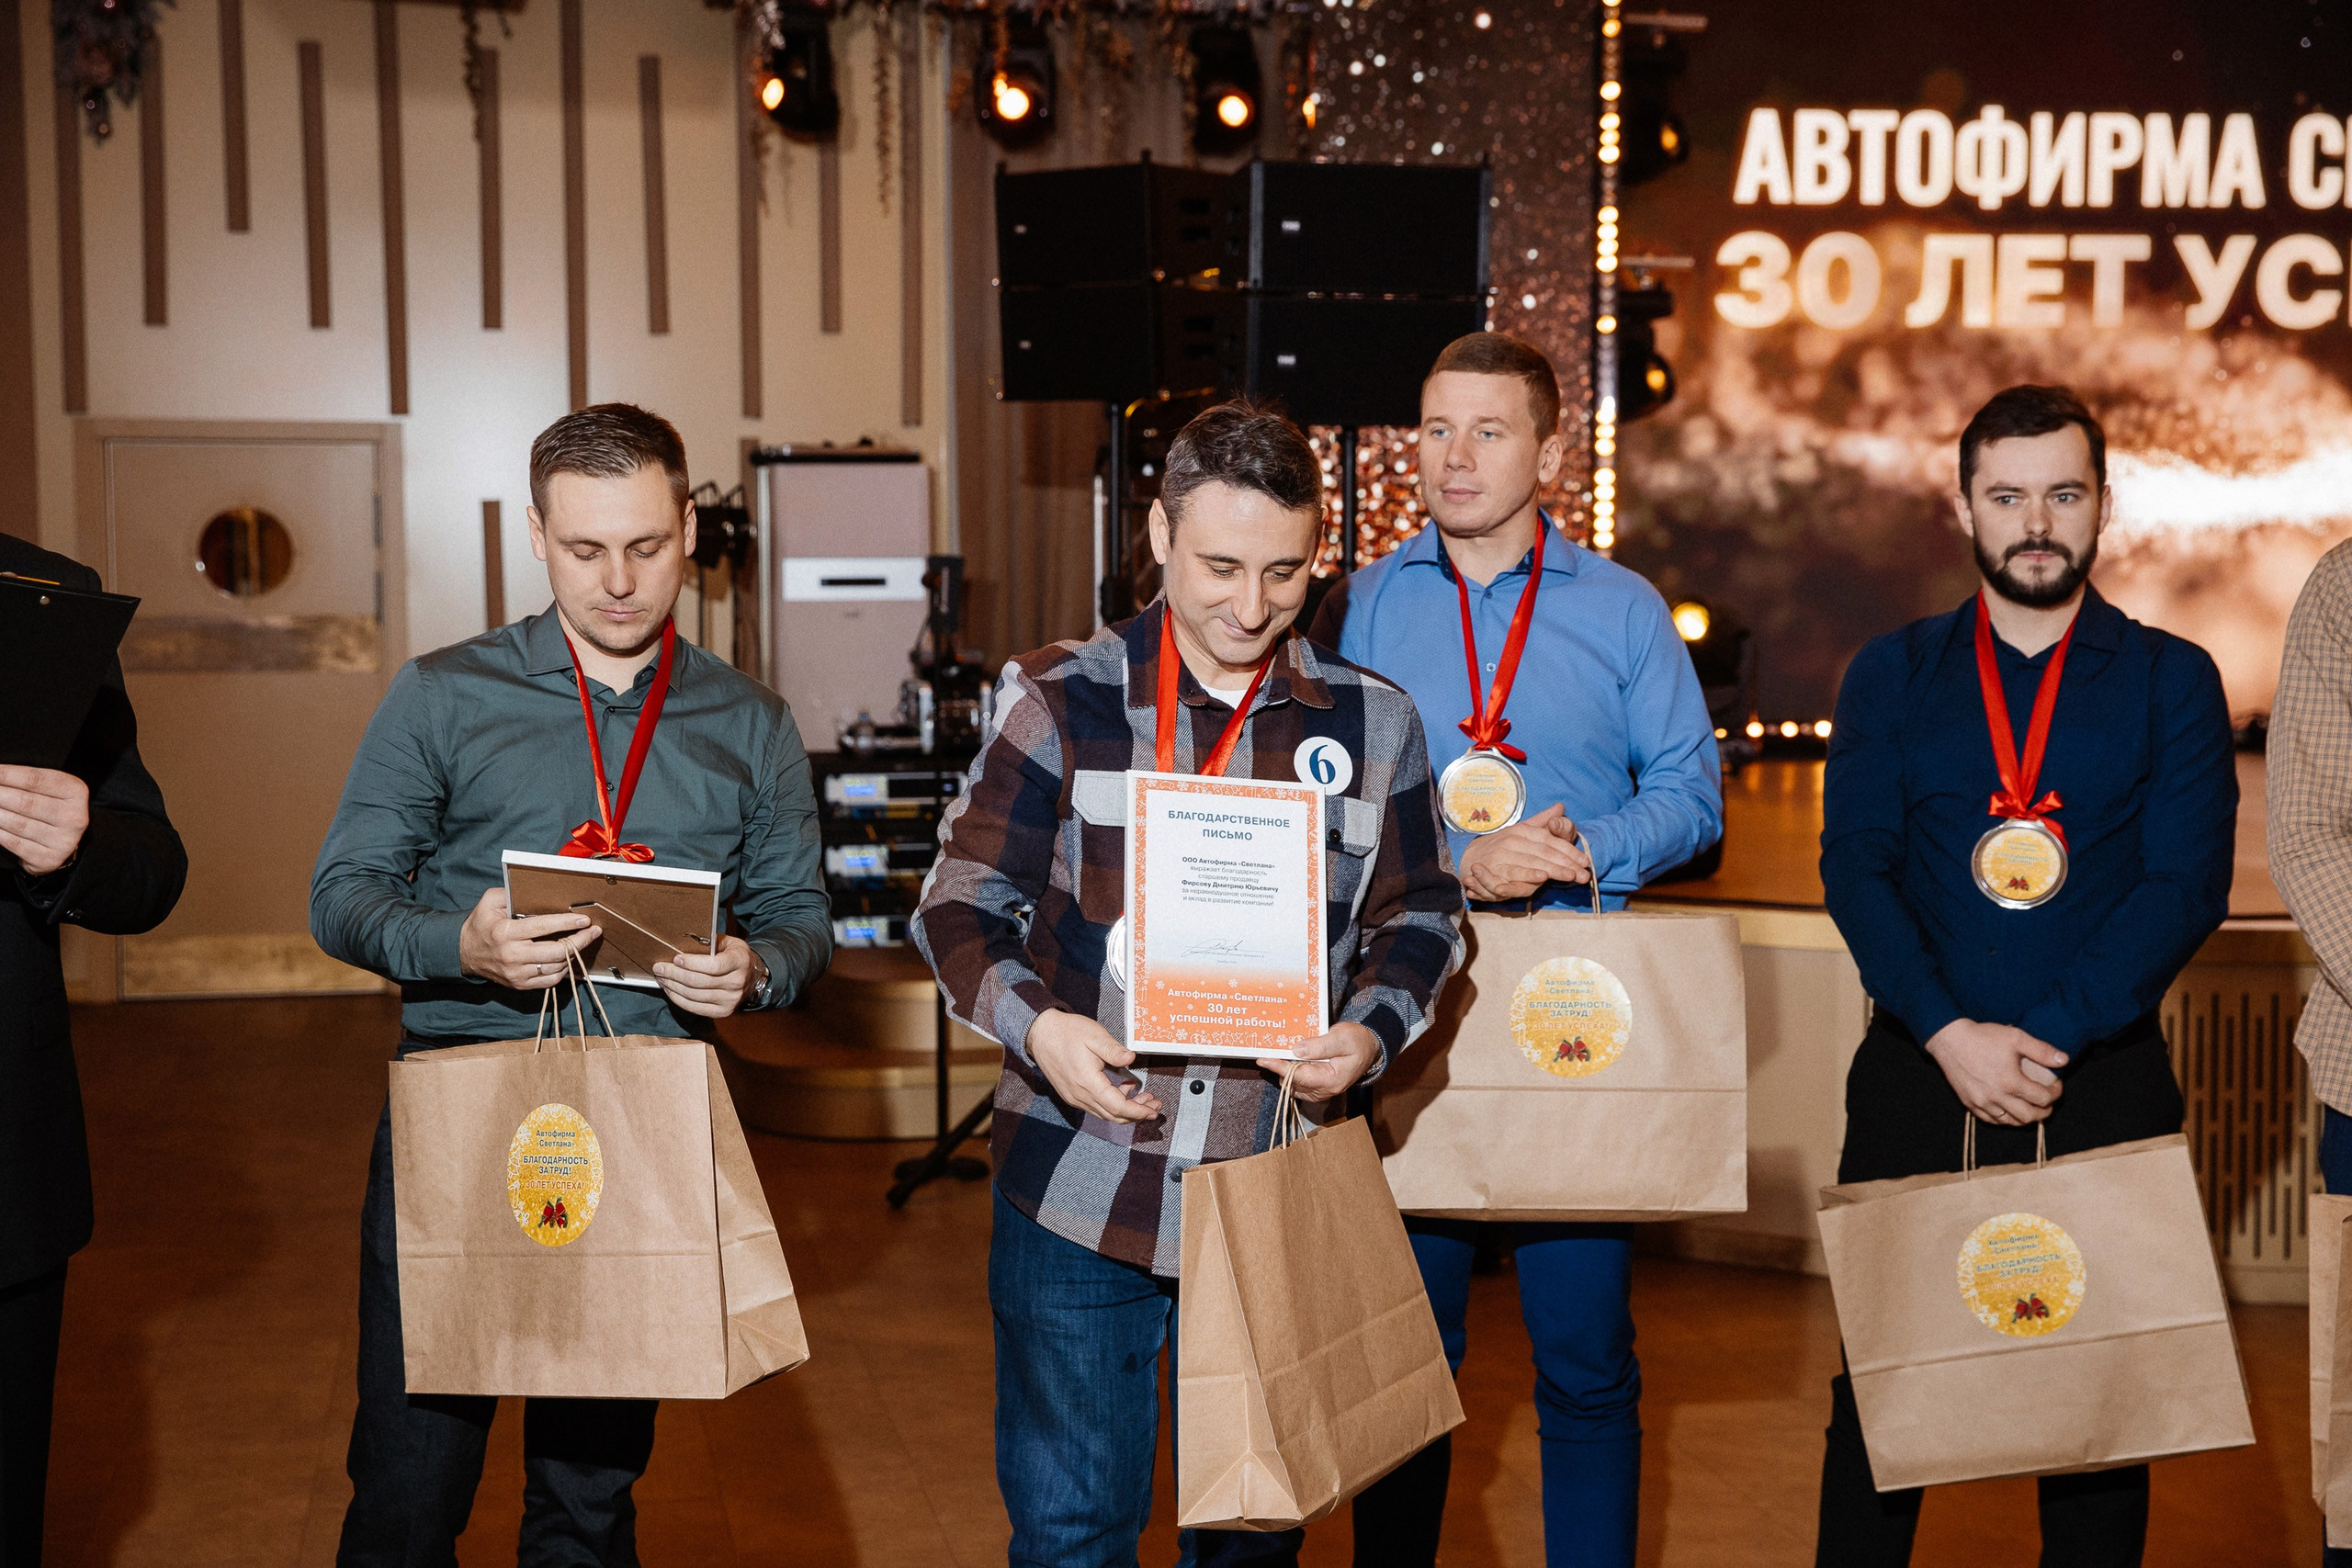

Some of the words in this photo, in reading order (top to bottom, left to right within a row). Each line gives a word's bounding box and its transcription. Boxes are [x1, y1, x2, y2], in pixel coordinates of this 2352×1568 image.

[1732, 104, 2267, 211] АВТОФИРМА
[2288, 111, 2352, 210] С
[1713, 230, 1883, 331] 30
[1905, 232, 2152, 331] ЛЕТ
[2172, 231, 2352, 332] УС
[1309, 744, 1336, 784] 6
[1168, 810, 1291, 828] БЛАГОДАРСТВЕННОЕ
[1202, 829, 1253, 840] ПИСЬМО
[1198, 858, 1238, 866] Автофирма
[1221, 867, 1268, 876] благодарность
[1182, 879, 1211, 888] Фирсову
[1212, 881, 1244, 890] Дмитрию
[1245, 884, 1279, 893] Юрьевичу
[1168, 987, 1227, 1000] Автофирма
[1229, 992, 1288, 1004] «Светлана»
[1207, 1002, 1224, 1013] 30
[1226, 1006, 1248, 1015] лет
[1529, 1001, 1612, 1010] БЛАГОДАРНОСТЬ
[1170, 1013, 1233, 1025] успешной
[1235, 1016, 1286, 1029] работы!
[536, 1129, 576, 1138] Автофирма
[523, 1156, 589, 1165] БЛАГОДАРНОСТЬ
[538, 1166, 548, 1174] ЗА
[549, 1166, 571, 1176] ТРУД!
[526, 1180, 534, 1189] 30
[536, 1180, 550, 1190] ЛЕТ
[551, 1181, 584, 1190] УСПЕХА!
